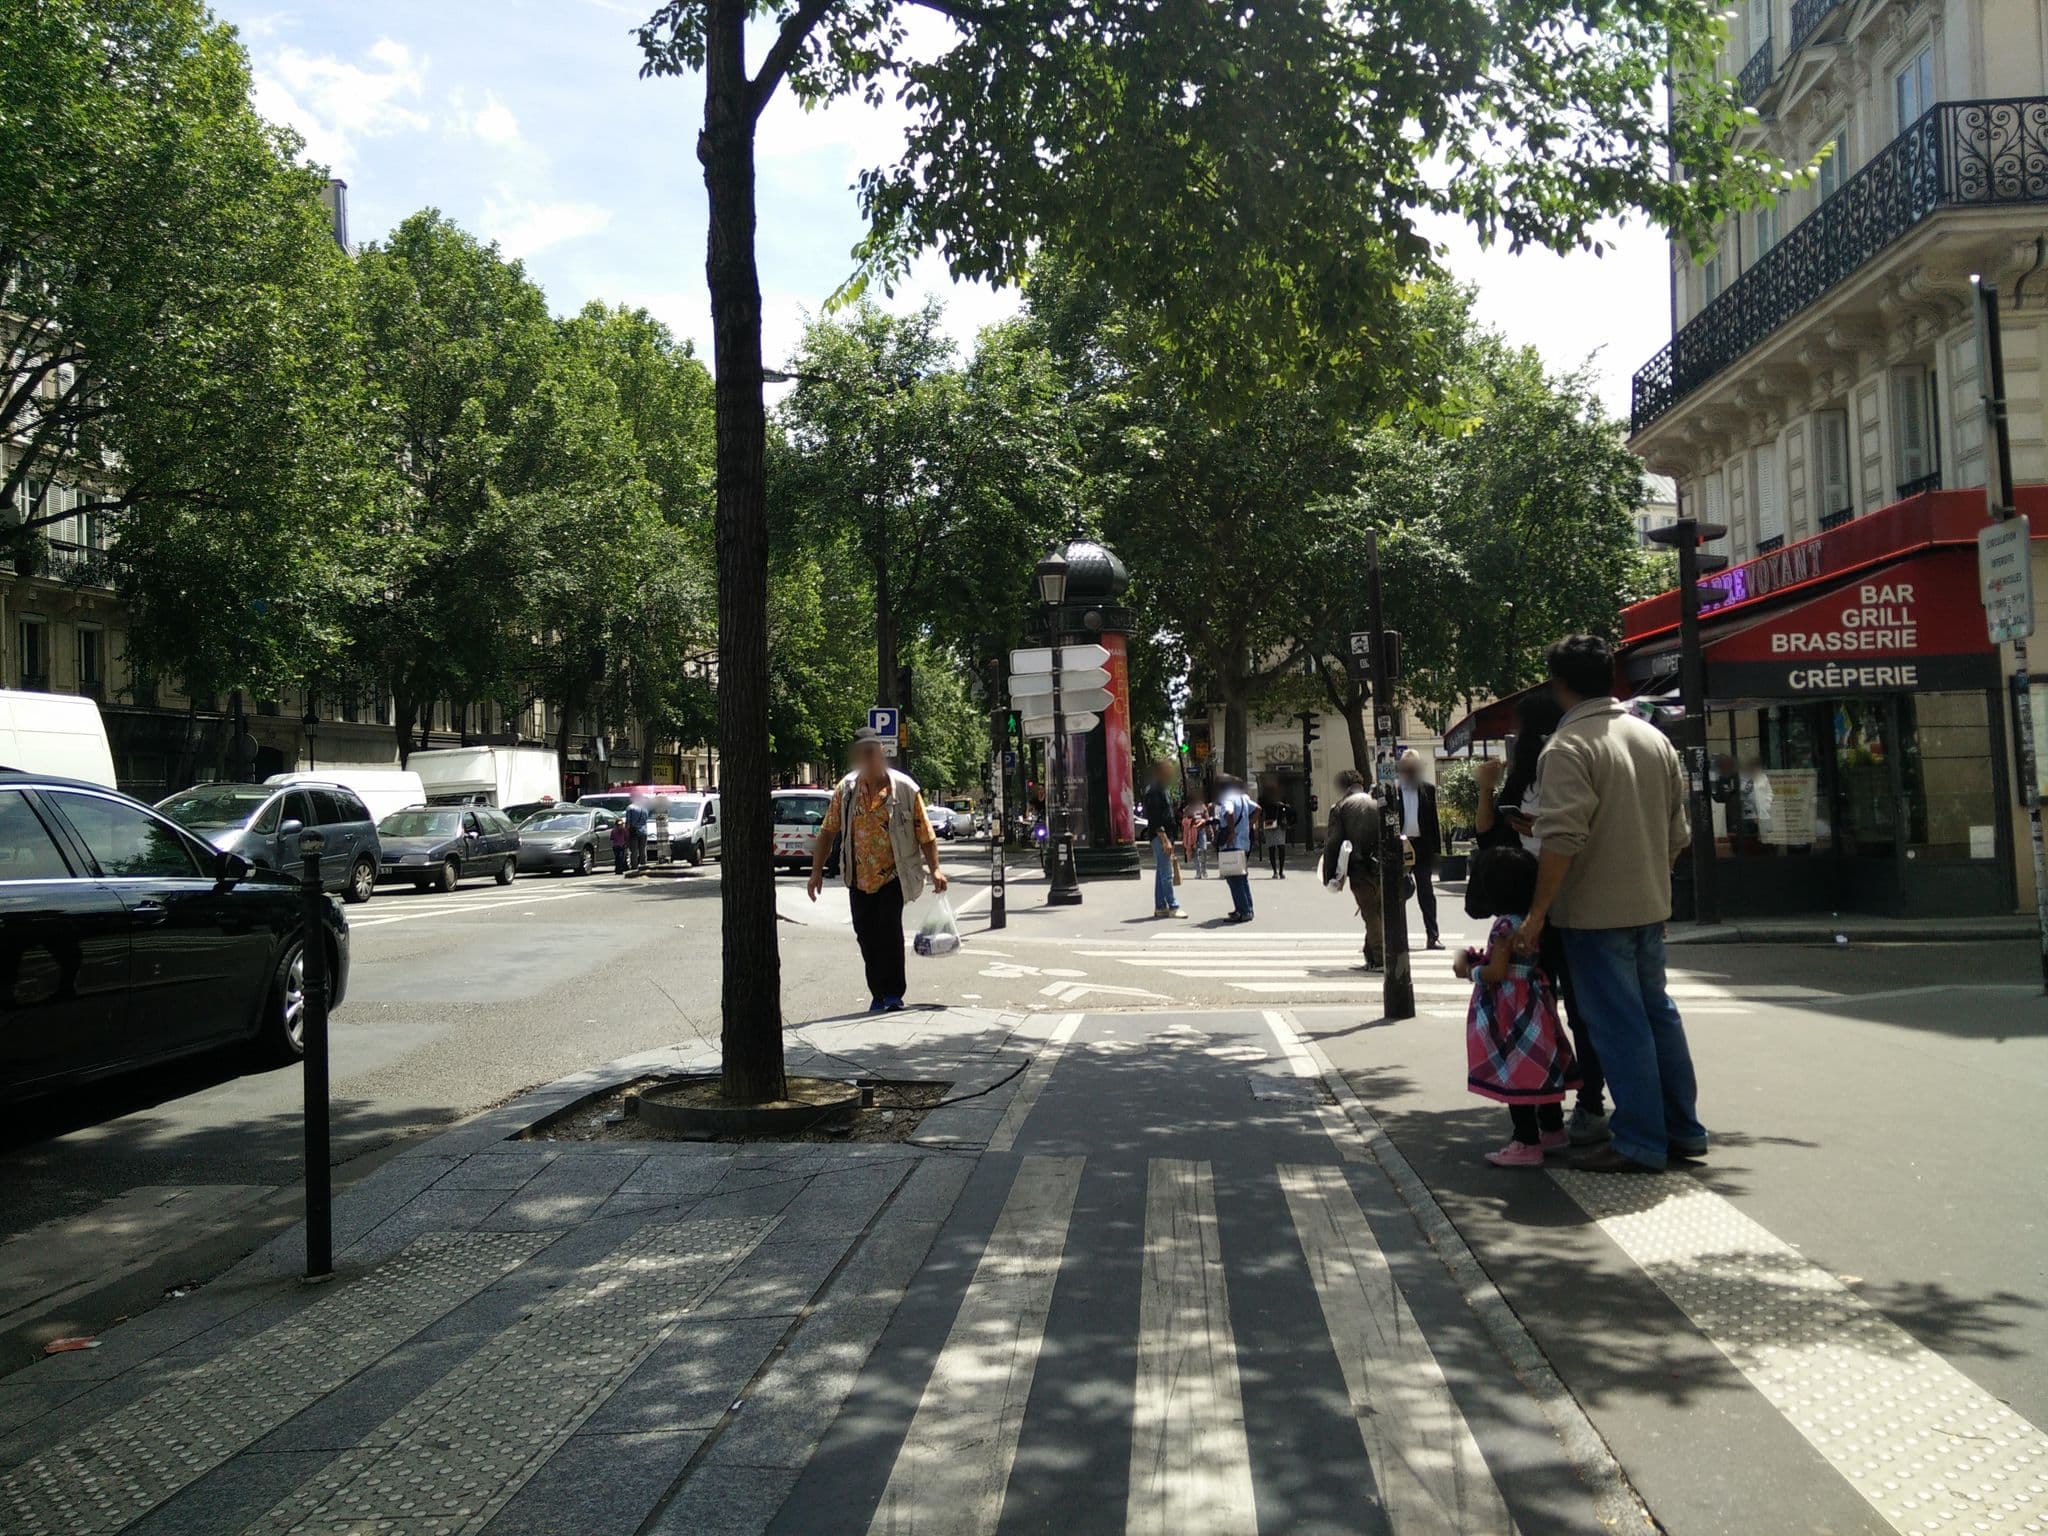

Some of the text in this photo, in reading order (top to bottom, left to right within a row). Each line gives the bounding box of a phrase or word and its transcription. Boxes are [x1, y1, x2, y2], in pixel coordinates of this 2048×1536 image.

[1860, 584, 1914, 605] BAR
[1841, 607, 1917, 628] GRILL
[1771, 629, 1917, 653] BRASSERIE
[1788, 662, 1918, 690] CRÊPERIE
[875, 712, 891, 734] P
